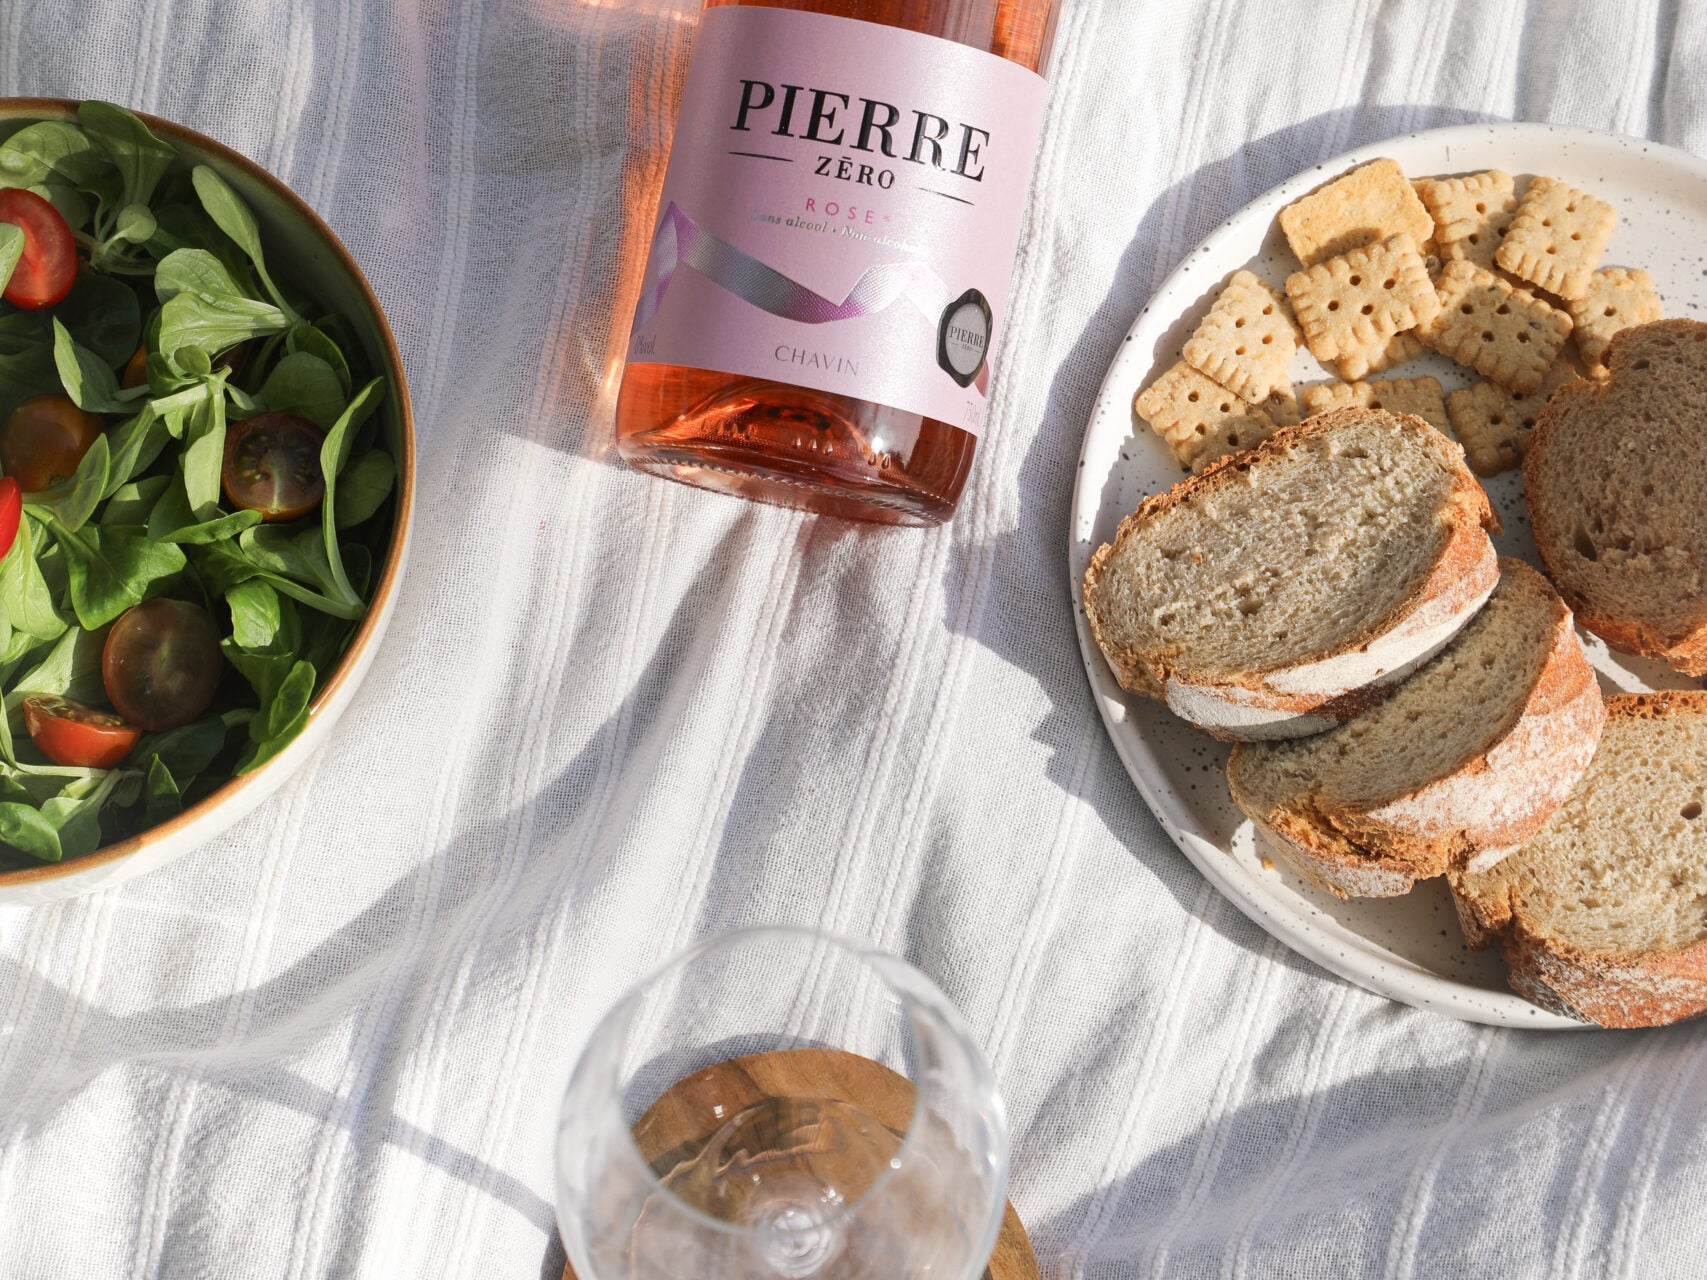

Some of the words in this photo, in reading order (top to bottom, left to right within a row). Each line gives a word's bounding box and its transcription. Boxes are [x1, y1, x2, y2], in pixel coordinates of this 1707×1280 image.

[729, 79, 991, 183] PIERRE
[785, 215, 828, 233] alcool
[948, 325, 985, 349] PIERRE
[774, 344, 860, 376] CHAVIN
